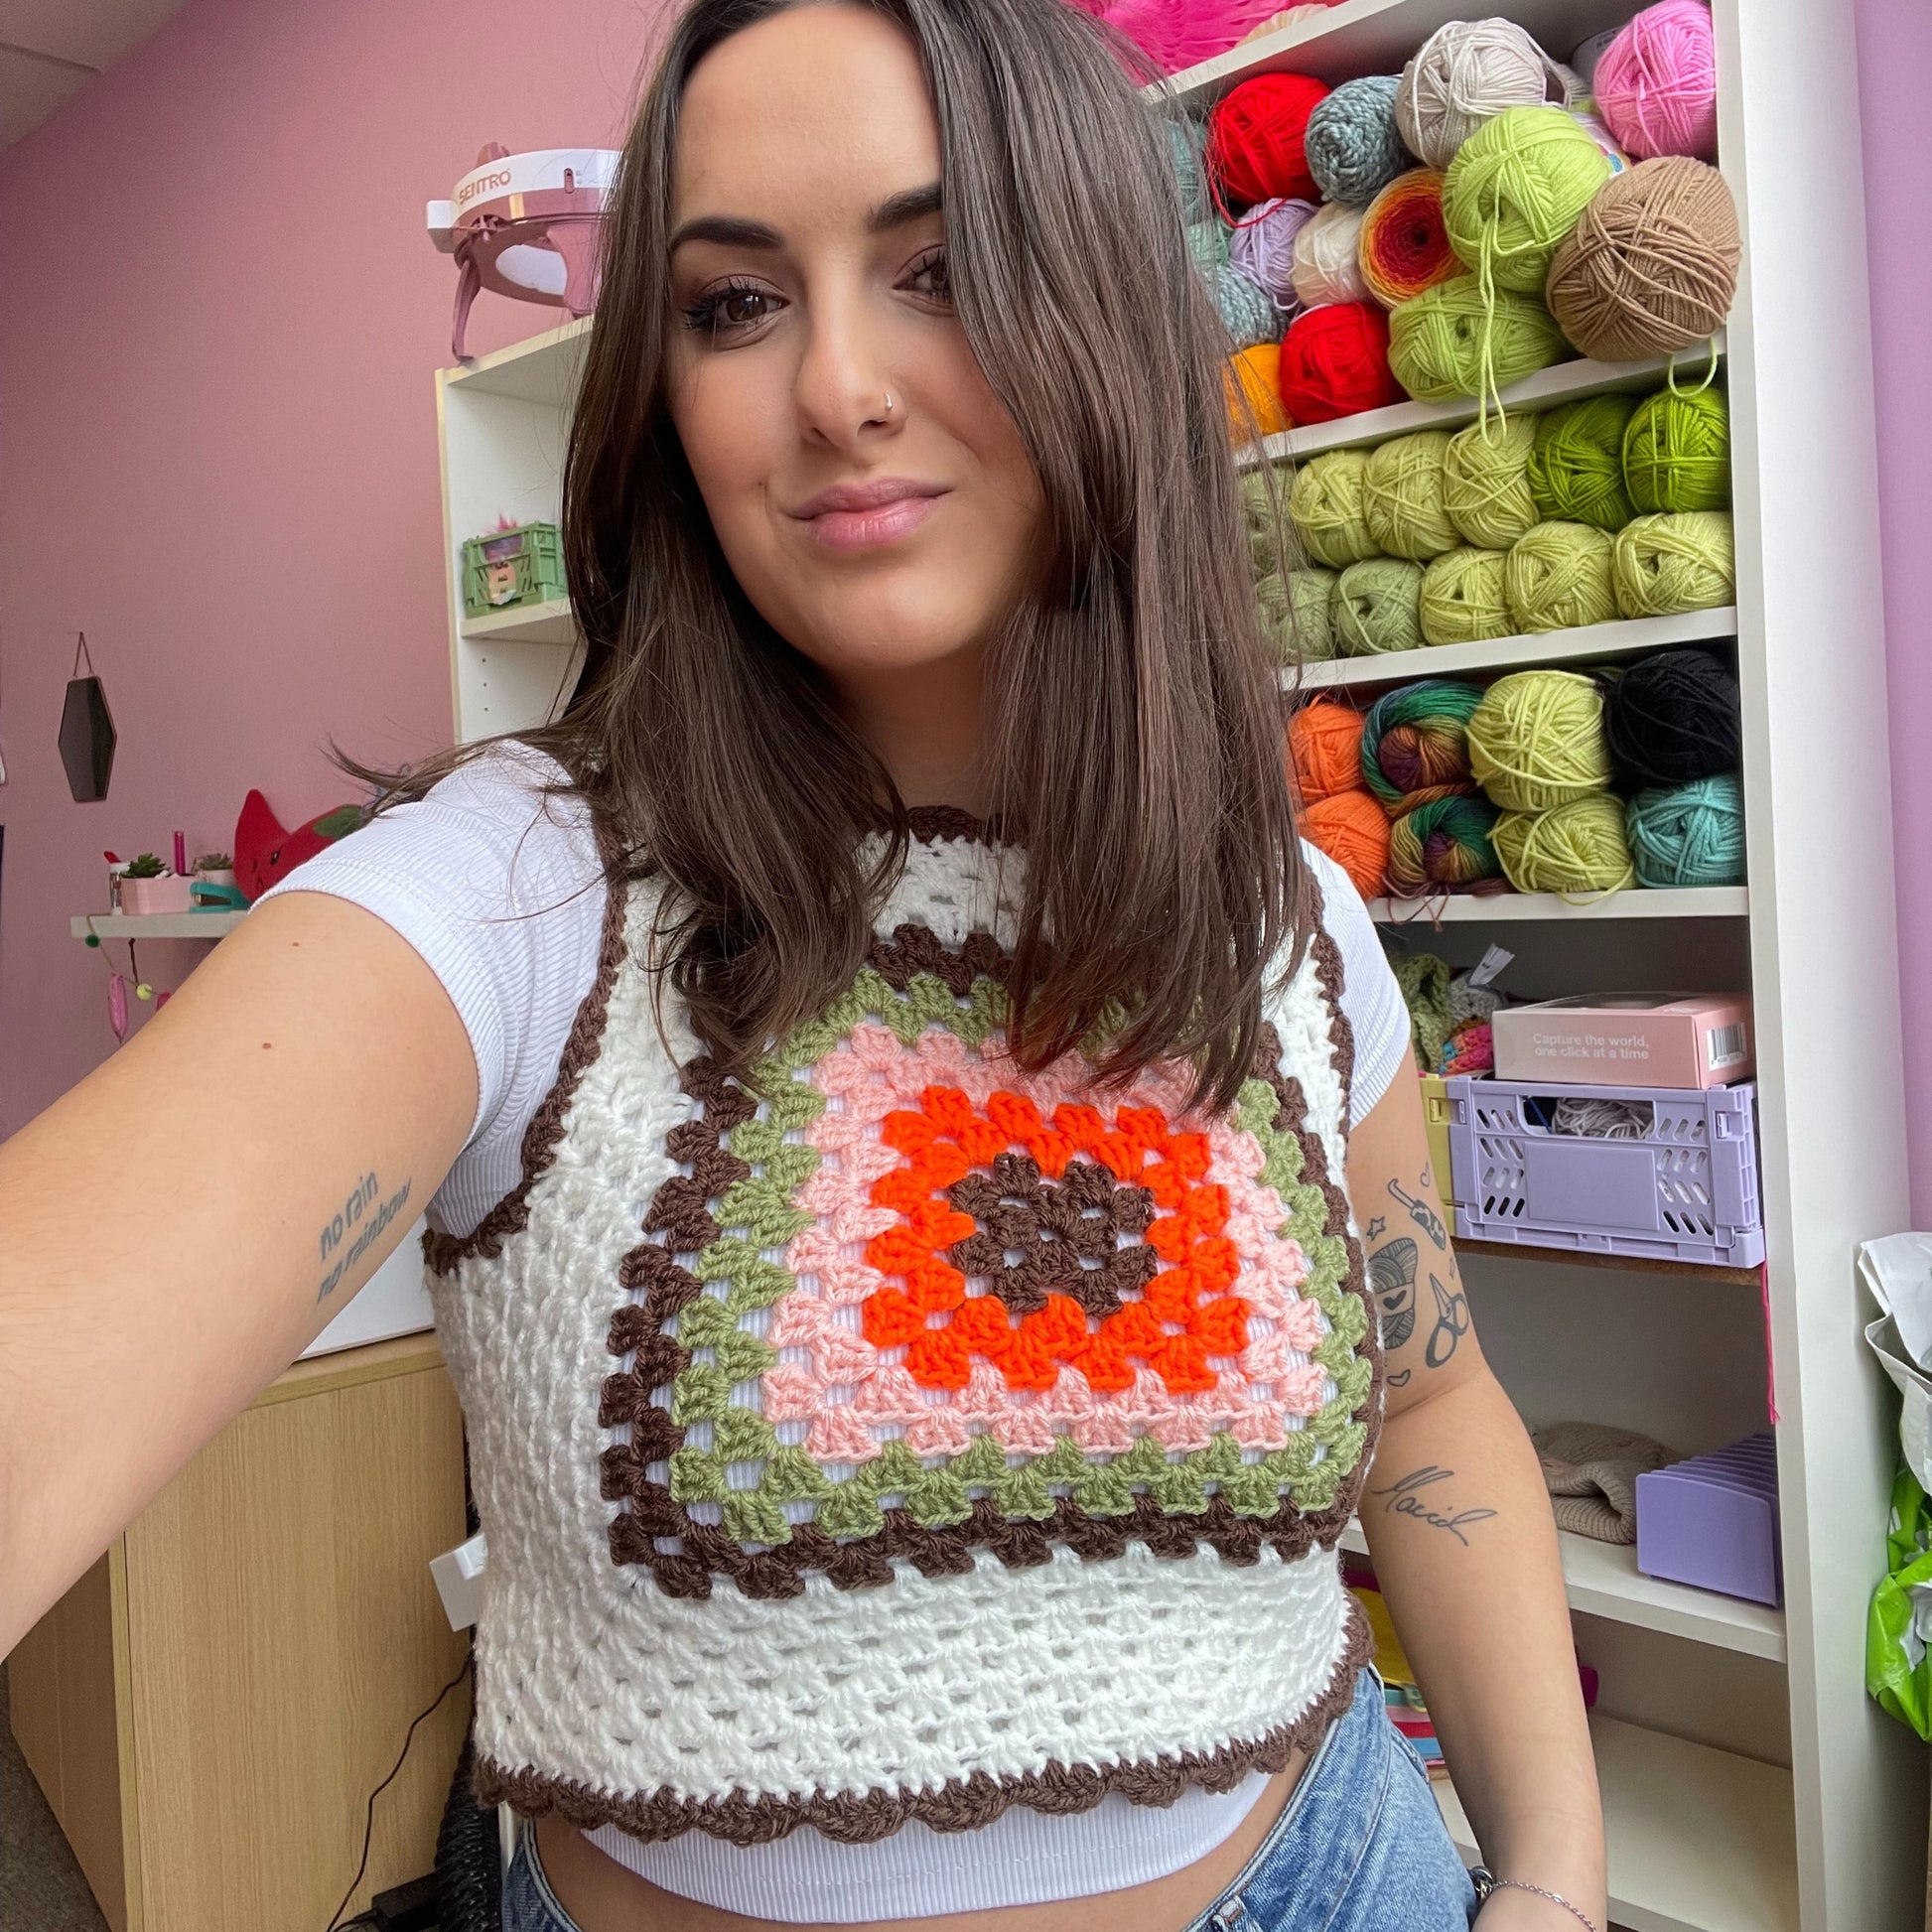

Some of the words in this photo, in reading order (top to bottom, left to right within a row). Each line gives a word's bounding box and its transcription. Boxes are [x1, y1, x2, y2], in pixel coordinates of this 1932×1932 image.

[459, 171, 511, 206] SENTRO
[1532, 1033, 1582, 1046] Capture
[1585, 1033, 1605, 1045] the
[1608, 1035, 1650, 1049] world,
[1534, 1046, 1558, 1056] one
[1560, 1045, 1589, 1058] click
[1592, 1047, 1605, 1058] at
[1608, 1049, 1617, 1058] a
[1620, 1048, 1649, 1059] time
[320, 1212, 344, 1262] no
[345, 1171, 378, 1228] rain
[345, 1176, 412, 1272] rainbow
